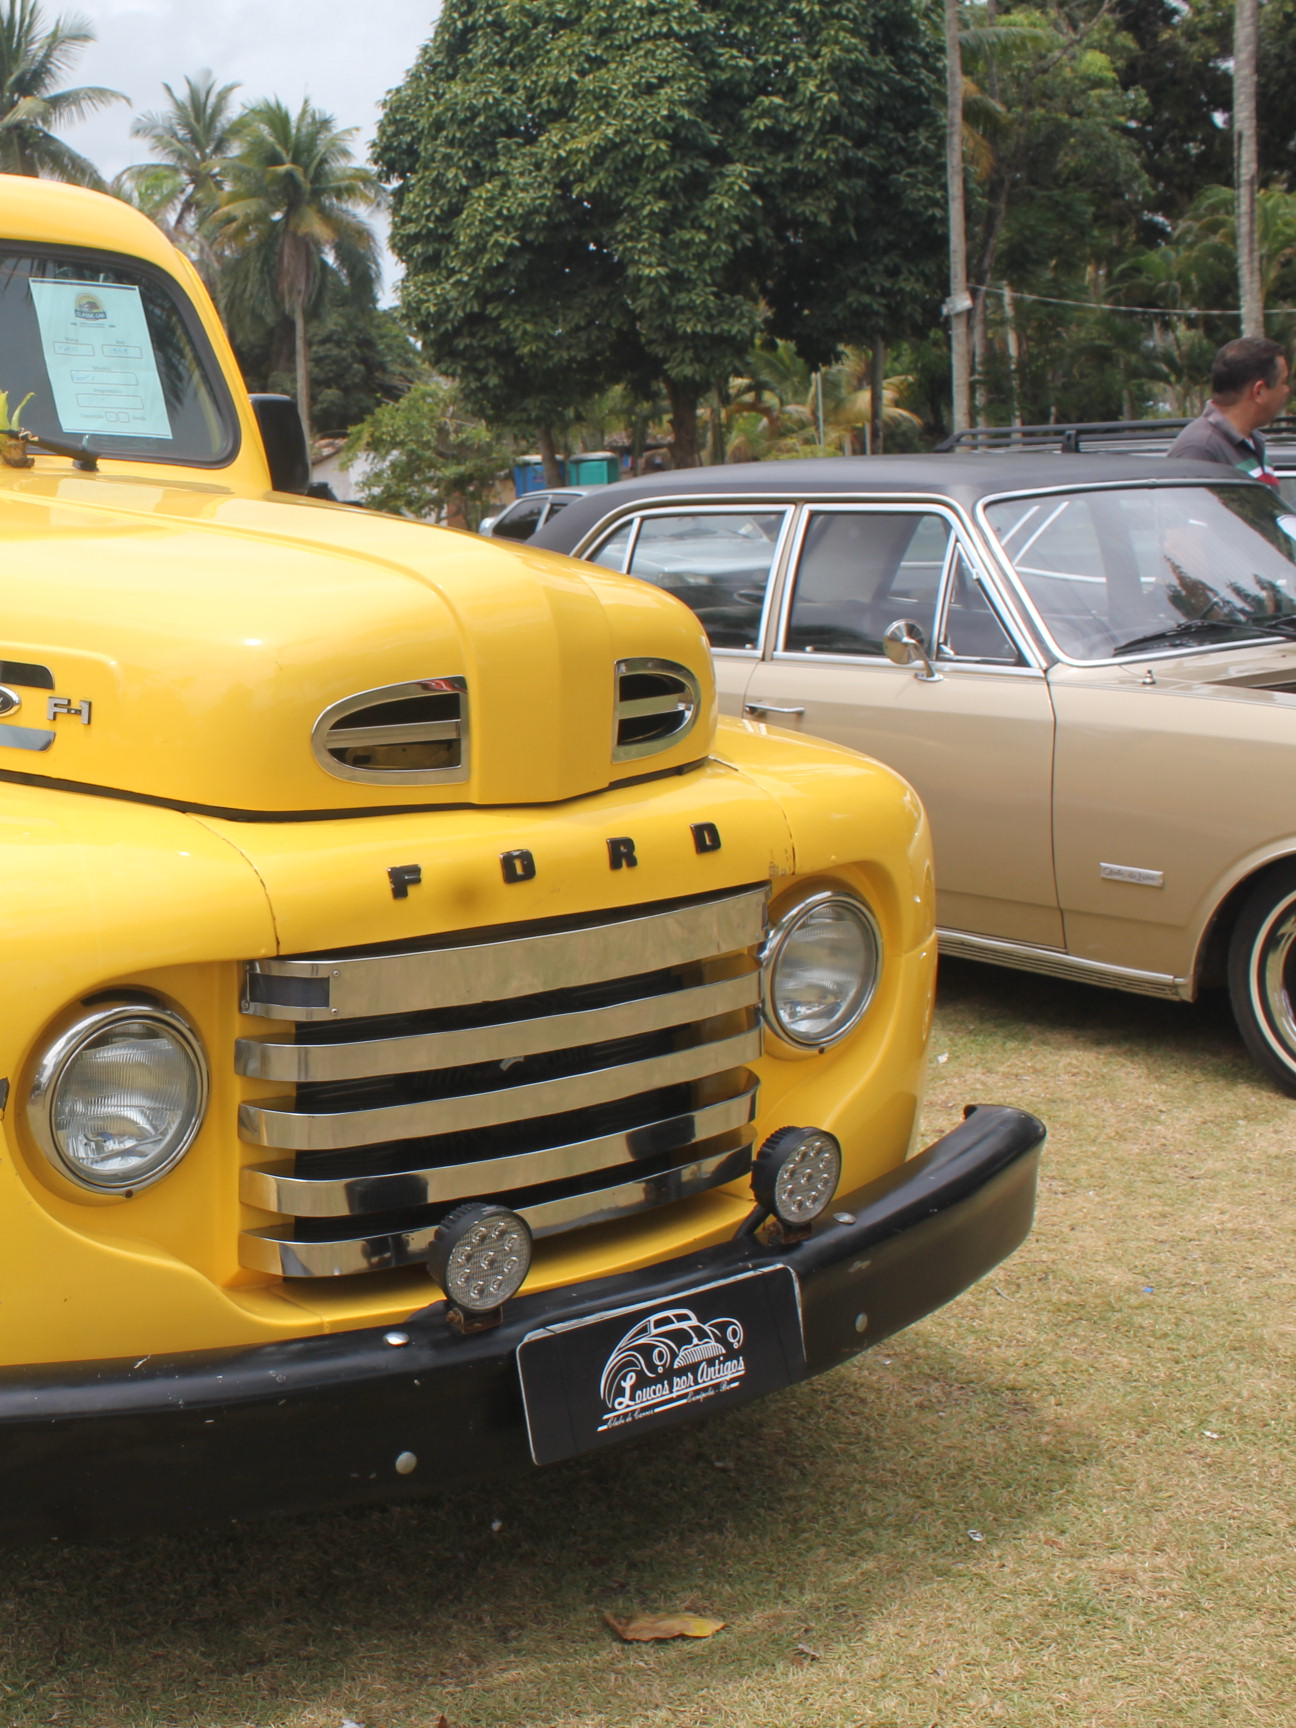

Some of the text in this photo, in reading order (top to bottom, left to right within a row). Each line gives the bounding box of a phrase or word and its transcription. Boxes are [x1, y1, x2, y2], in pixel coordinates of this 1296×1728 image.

[47, 696, 92, 725] F-1
[387, 822, 722, 900] FORD
[614, 1356, 746, 1410] Loucos por Antigos
